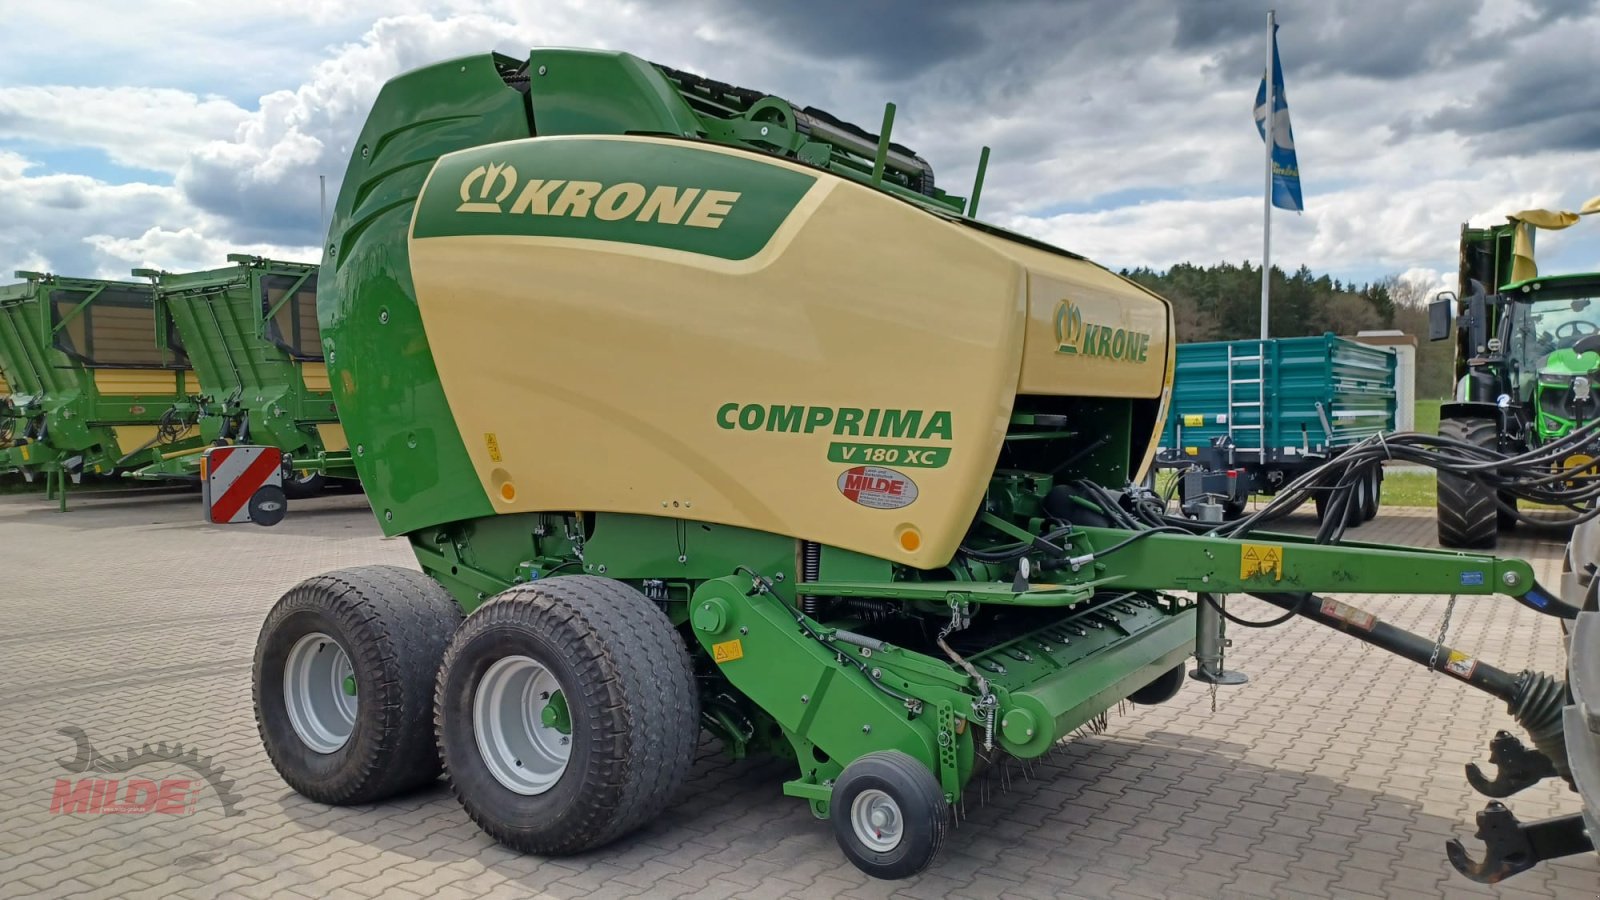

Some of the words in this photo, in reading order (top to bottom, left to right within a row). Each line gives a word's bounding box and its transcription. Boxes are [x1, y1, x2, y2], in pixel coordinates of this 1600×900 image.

[509, 179, 742, 229] KRONE
[1082, 323, 1150, 362] KRONE
[716, 402, 953, 440] COMPRIMA
[841, 446, 857, 460] V
[864, 447, 899, 462] 180
[904, 449, 937, 465] XC
[844, 474, 905, 496] MILDE
